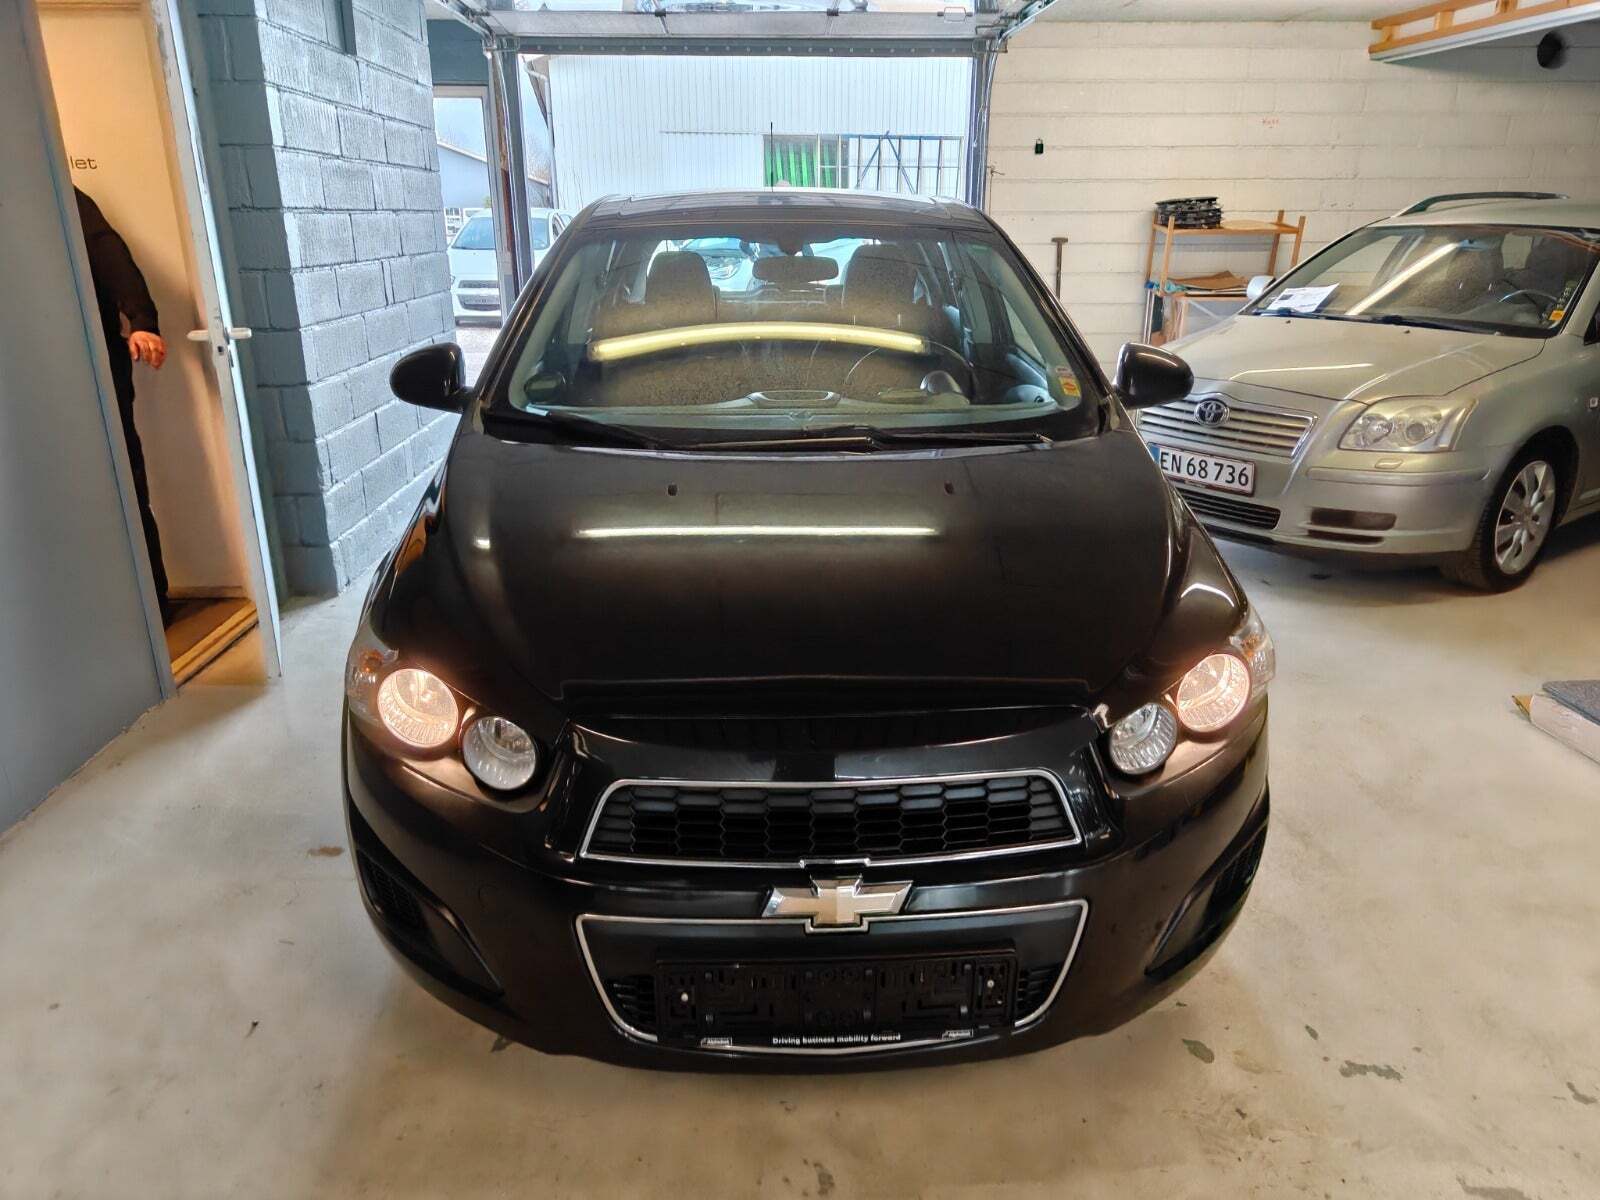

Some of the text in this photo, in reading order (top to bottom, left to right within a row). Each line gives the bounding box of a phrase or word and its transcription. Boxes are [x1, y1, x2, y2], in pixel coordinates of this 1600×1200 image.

[70, 156, 97, 169] let
[1160, 452, 1249, 486] EN 68 736
[772, 1033, 901, 1045] Driving business mobility forward
